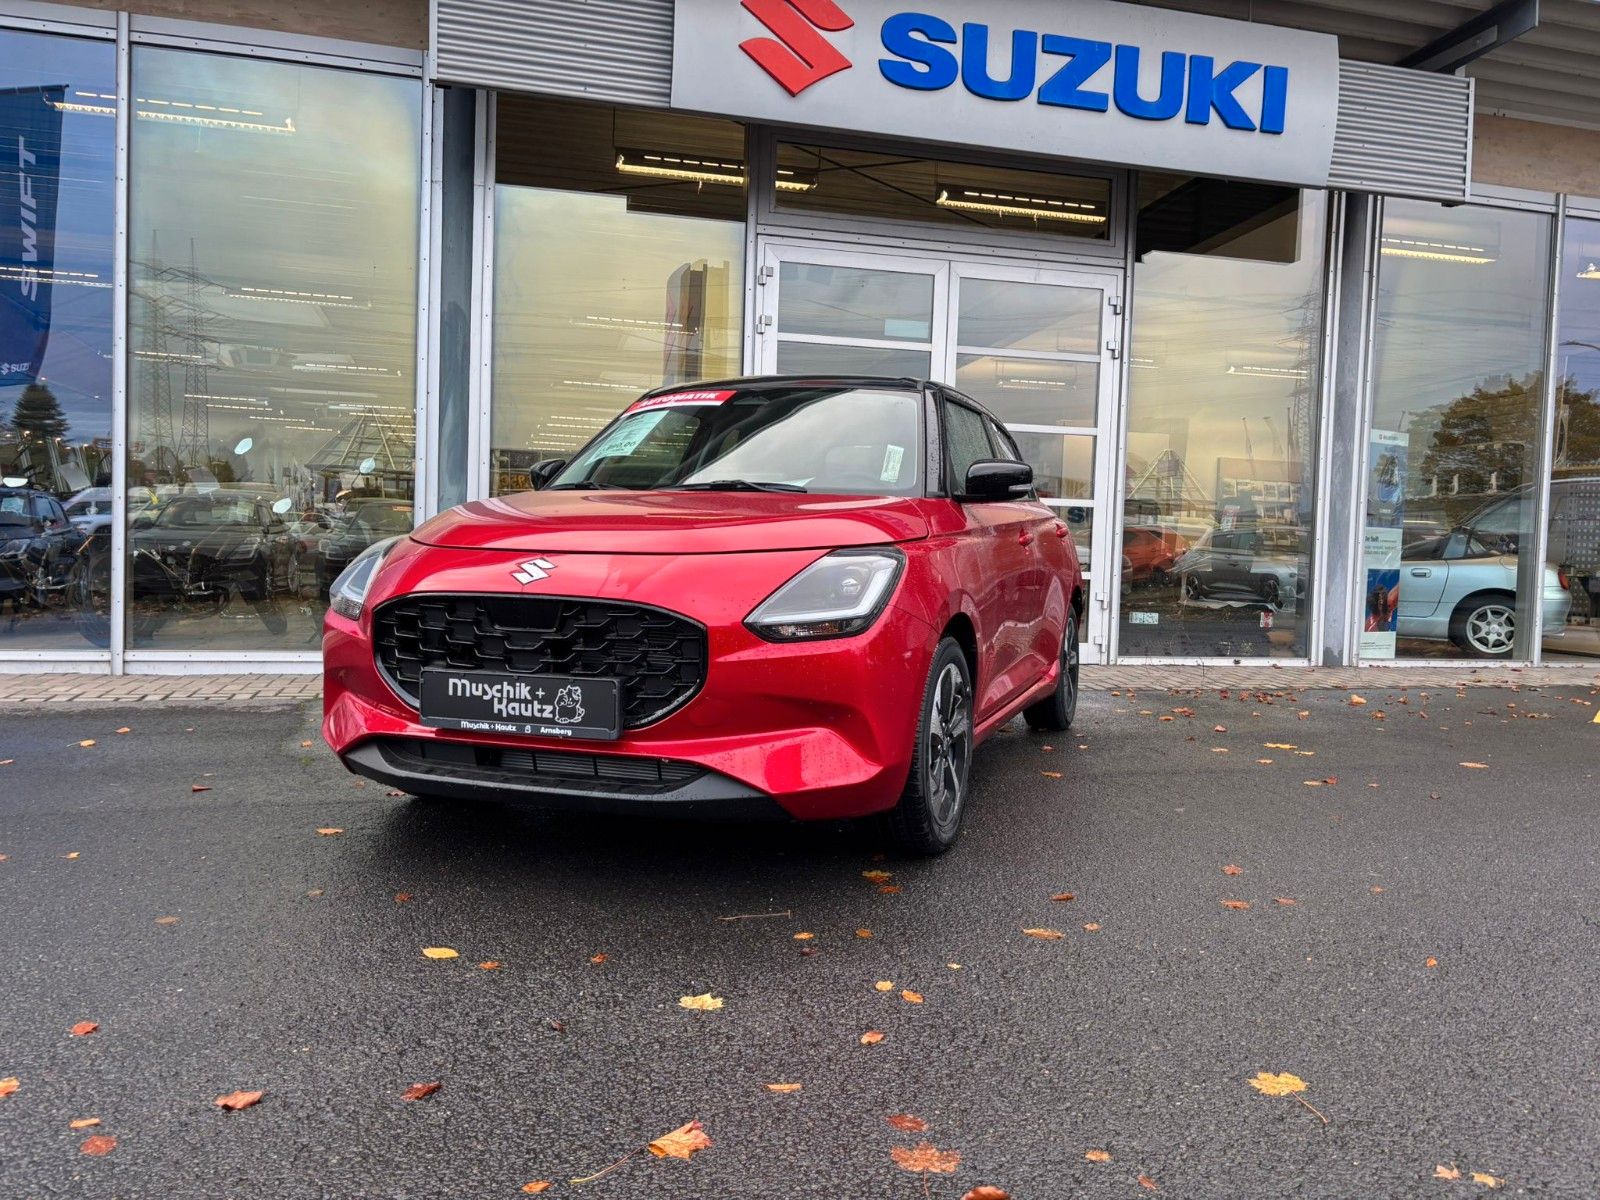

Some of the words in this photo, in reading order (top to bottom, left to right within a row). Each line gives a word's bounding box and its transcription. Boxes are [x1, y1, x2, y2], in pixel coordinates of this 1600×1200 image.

[878, 11, 1288, 135] SUZUKI
[18, 134, 38, 302] SWIFT
[638, 392, 720, 407] AUTOMATIK
[448, 677, 531, 700] Muschik
[460, 720, 490, 731] Muschik
[540, 726, 573, 736] Arnsberg
